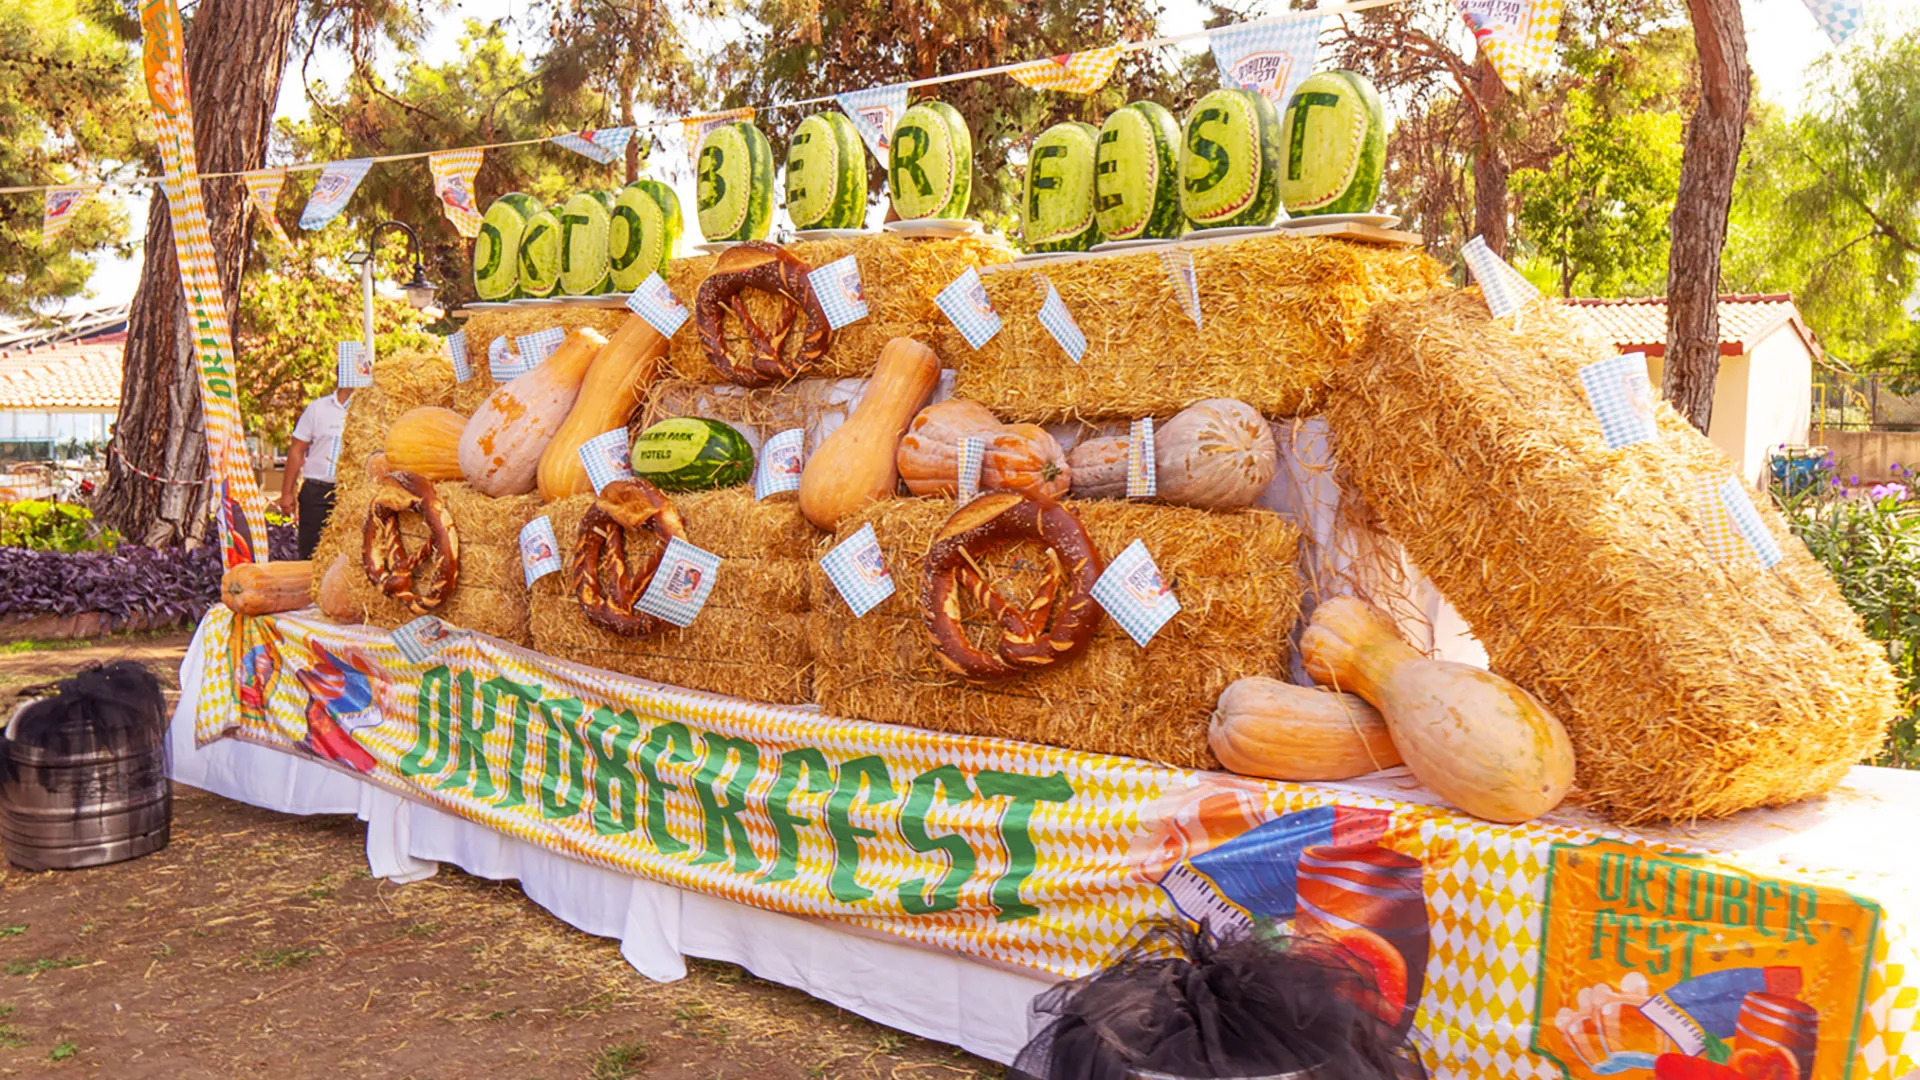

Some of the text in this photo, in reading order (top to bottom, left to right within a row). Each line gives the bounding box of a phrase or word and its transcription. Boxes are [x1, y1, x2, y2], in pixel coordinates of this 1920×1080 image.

[640, 449, 672, 460] HOTELS
[399, 664, 1074, 922] OKTOBERFEST
[1598, 852, 1818, 945] OKTOBER
[1588, 908, 1709, 983] FEST
